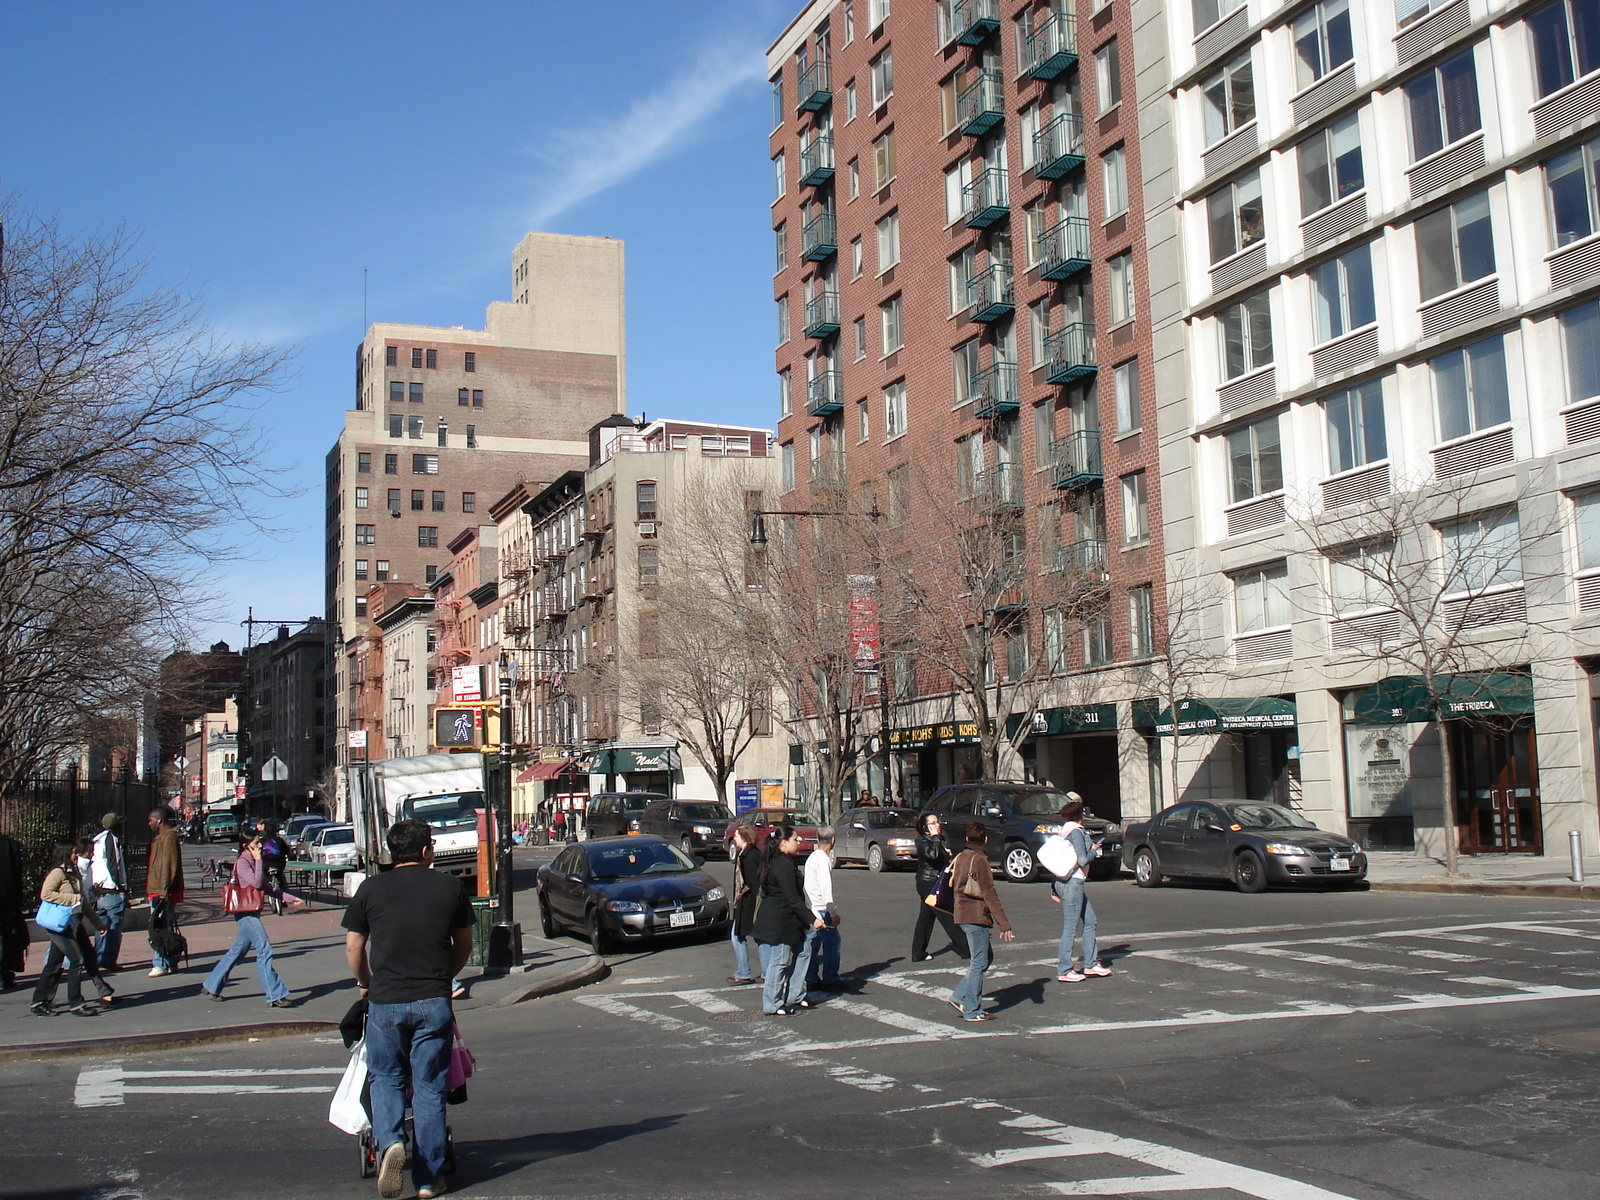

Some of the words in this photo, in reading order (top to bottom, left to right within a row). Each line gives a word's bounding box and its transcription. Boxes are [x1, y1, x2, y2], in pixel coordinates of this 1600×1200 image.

[1449, 702, 1464, 712] THE
[1465, 700, 1495, 711] TRIBECA
[1085, 712, 1099, 723] 311
[1391, 707, 1403, 717] 303
[959, 723, 978, 736] KOH'S
[635, 755, 659, 766] Nail
